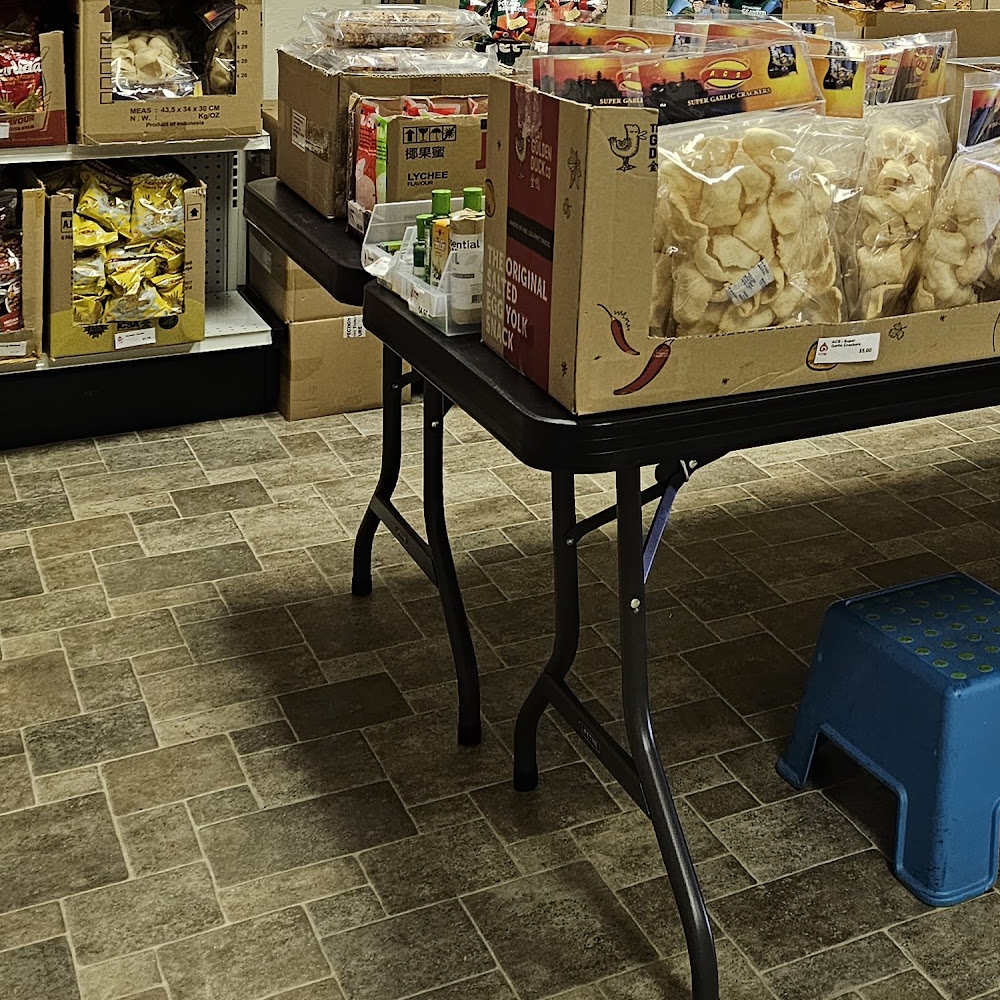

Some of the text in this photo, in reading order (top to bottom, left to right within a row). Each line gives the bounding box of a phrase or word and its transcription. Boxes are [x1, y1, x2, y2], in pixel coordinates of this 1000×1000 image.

[599, 98, 622, 106] SUPER
[687, 87, 771, 106] SUPER GARLIC CRACKERS
[405, 146, 445, 160] 椰果蜜
[407, 171, 448, 181] LYCHEE
[486, 268, 518, 305] SALTED
[487, 245, 548, 302] THE ORIGINAL
[486, 293, 528, 339] EGG YOLK
[486, 316, 514, 352] SNACK
